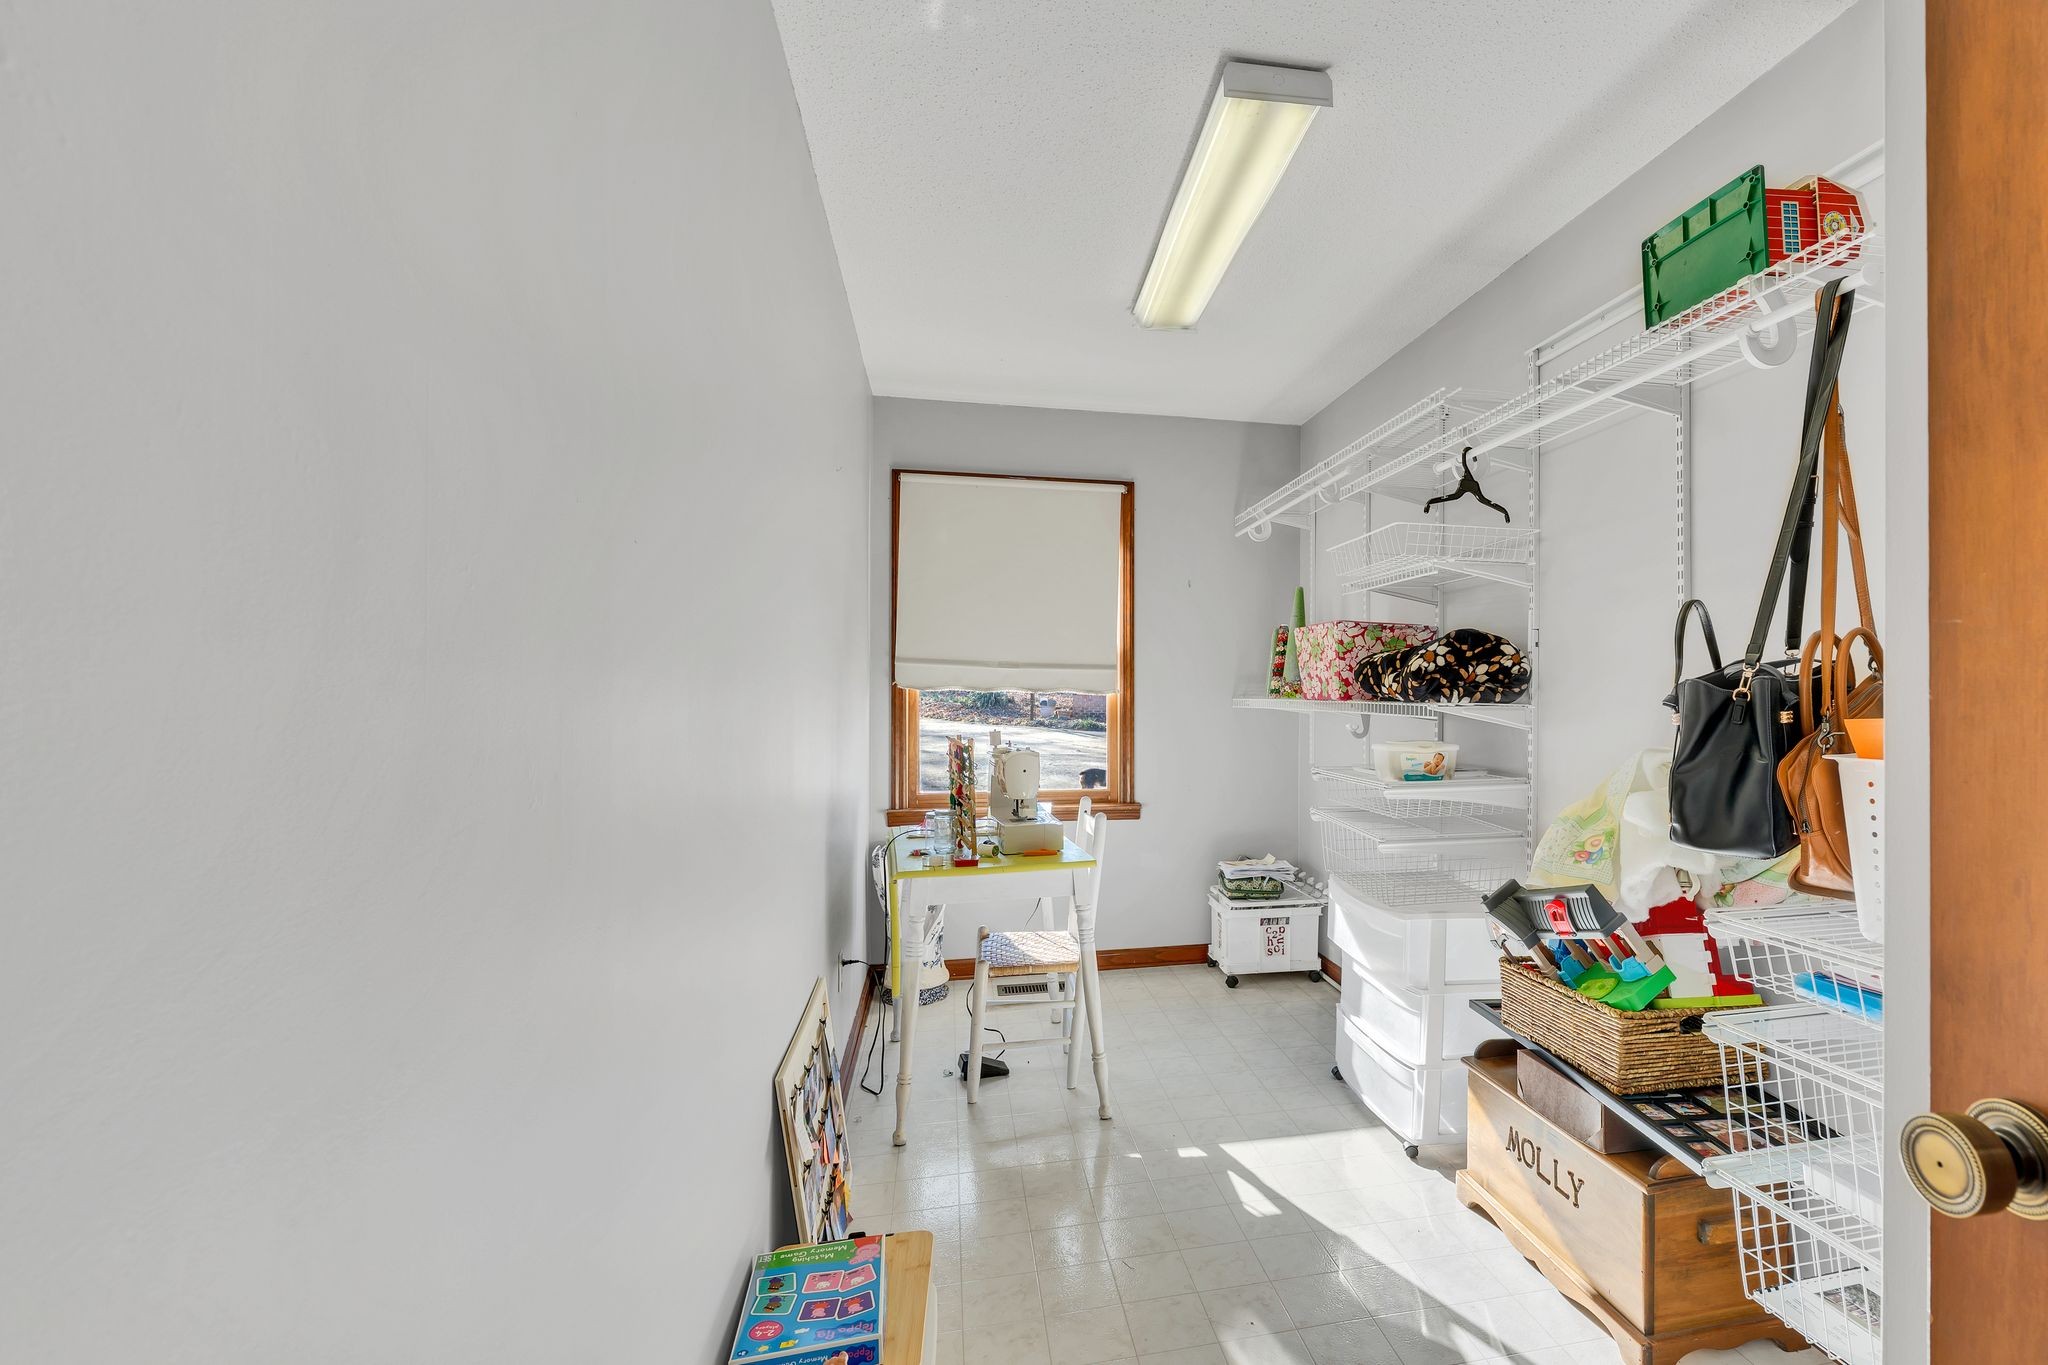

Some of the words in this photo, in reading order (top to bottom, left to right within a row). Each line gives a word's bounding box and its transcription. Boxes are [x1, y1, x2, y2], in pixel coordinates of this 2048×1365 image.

[1506, 1126, 1584, 1208] MOLLY
[810, 1245, 847, 1254] Memory
[760, 1255, 772, 1263] SET
[780, 1251, 807, 1259] Game
[792, 1253, 834, 1262] Matching
[838, 1322, 874, 1333] Peppa
[847, 1346, 873, 1361] Peppa
[799, 1356, 828, 1364] Memory
